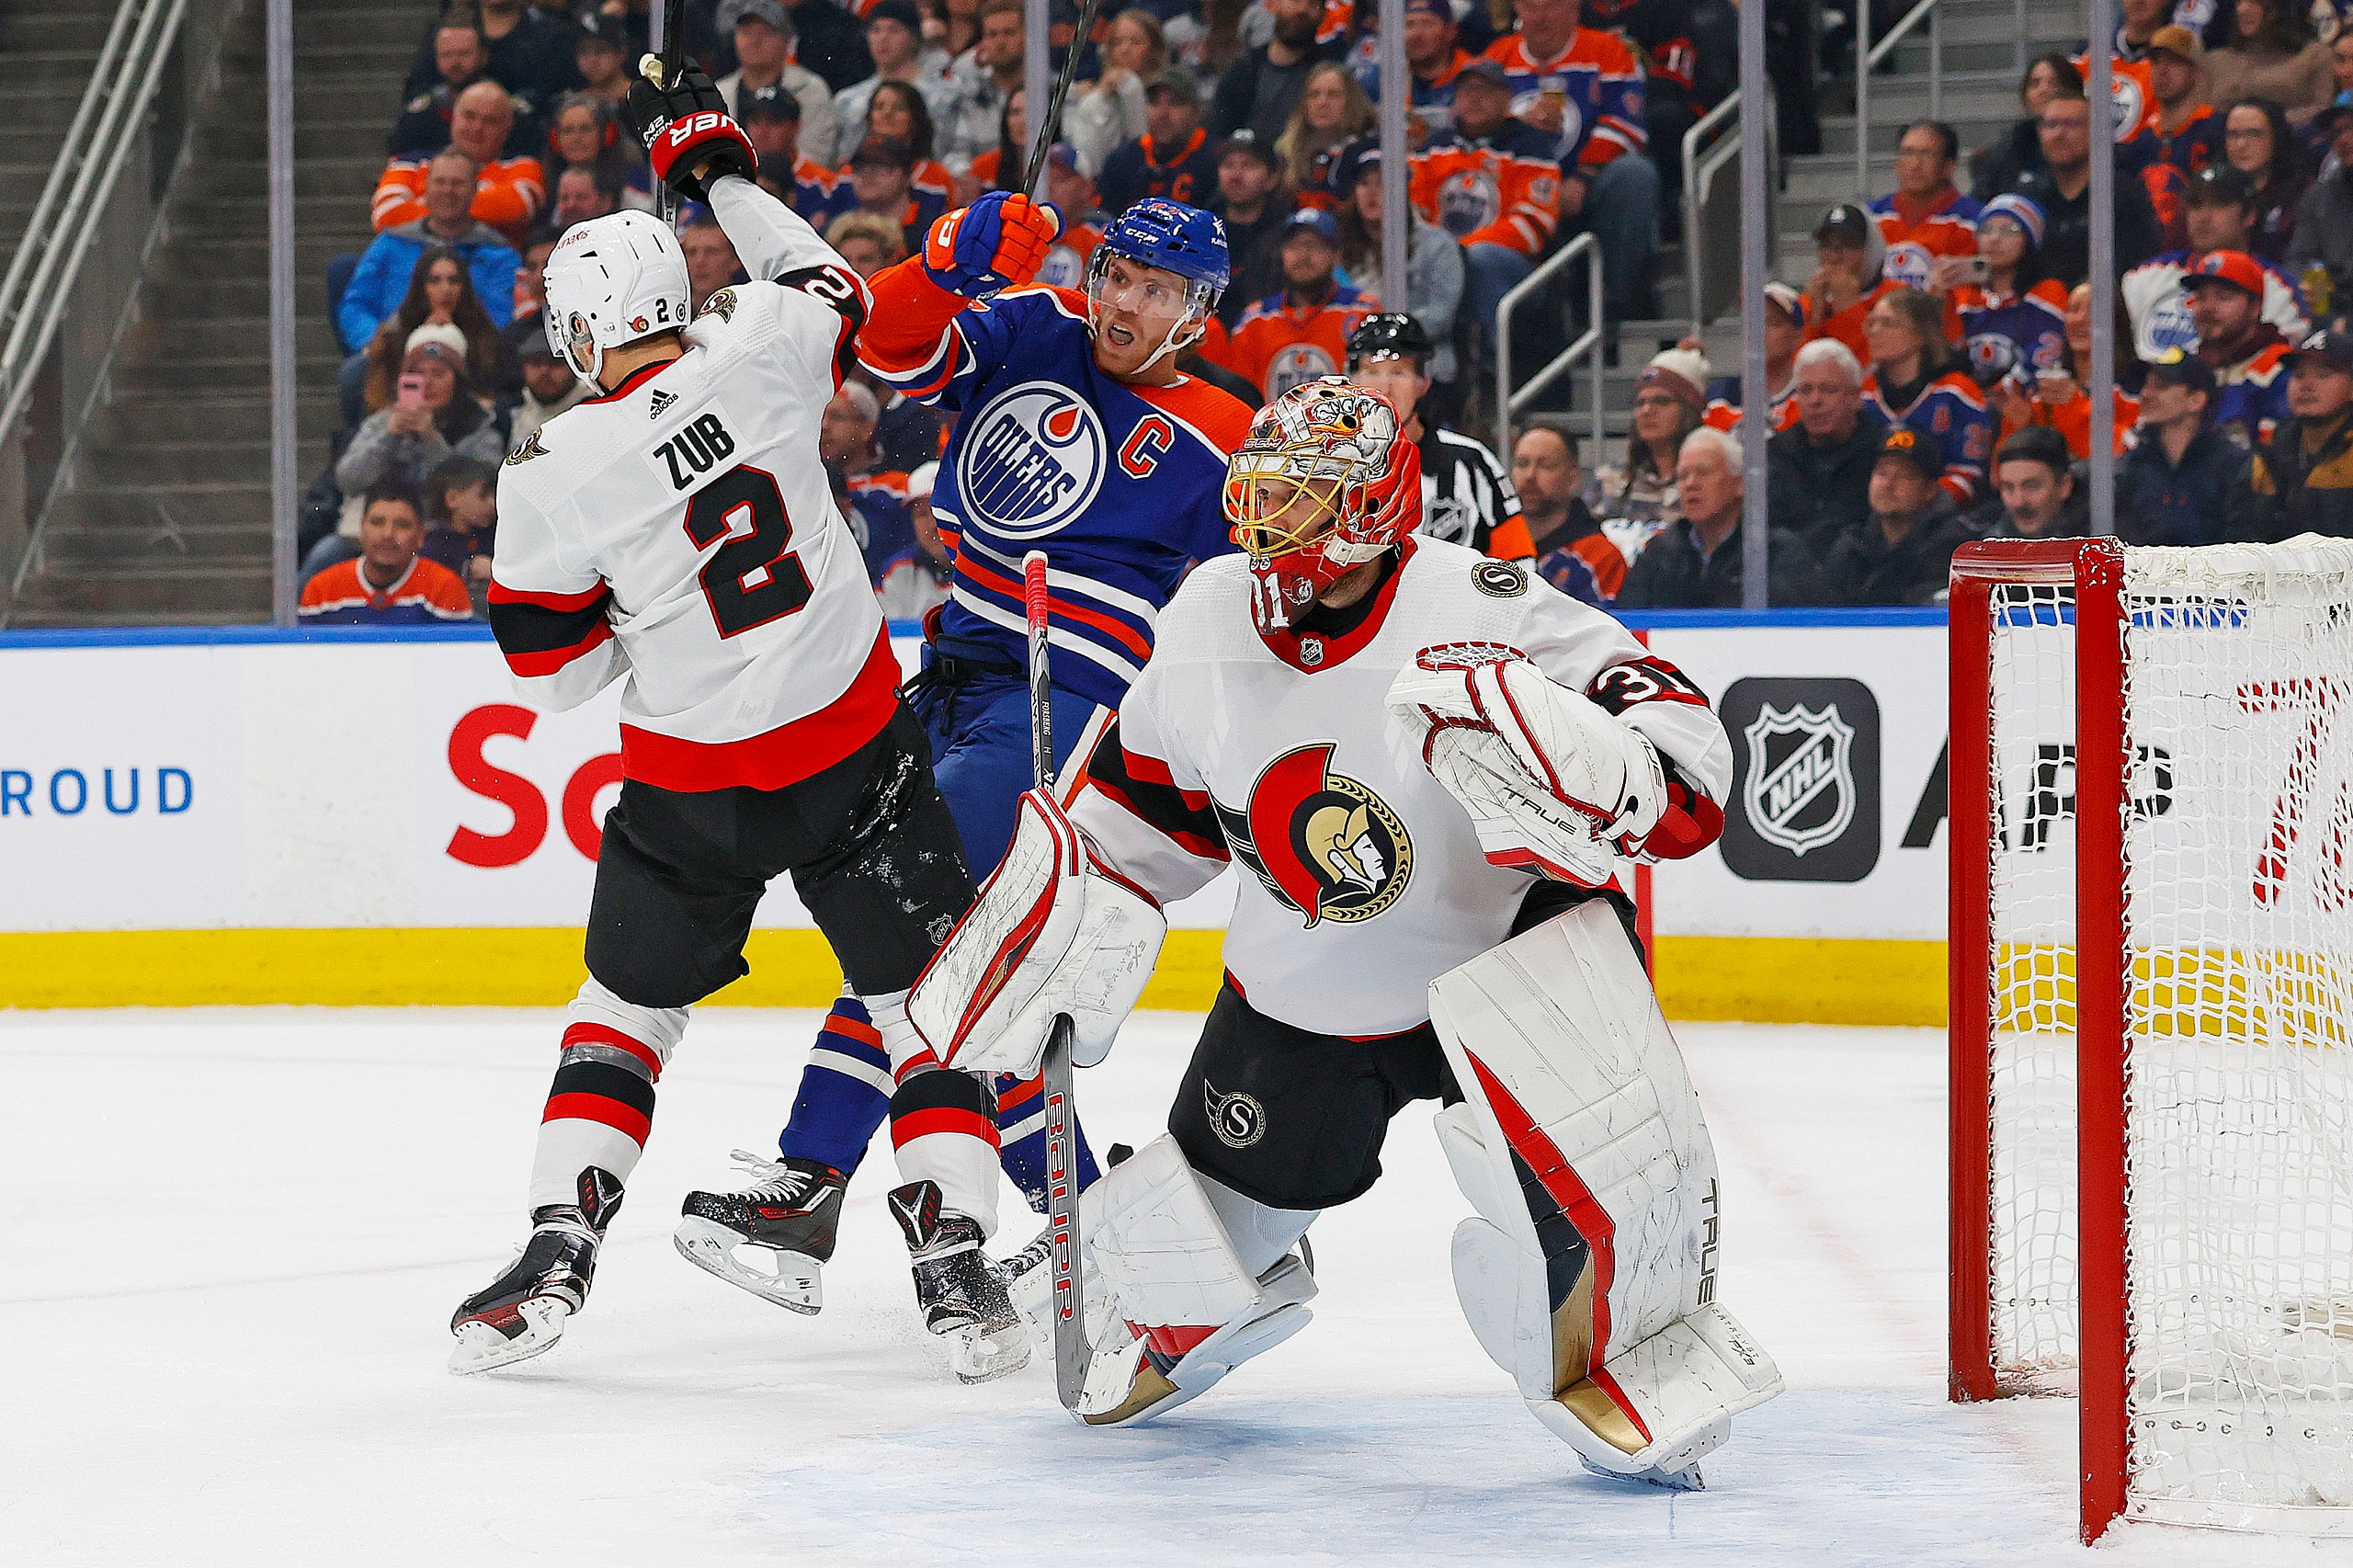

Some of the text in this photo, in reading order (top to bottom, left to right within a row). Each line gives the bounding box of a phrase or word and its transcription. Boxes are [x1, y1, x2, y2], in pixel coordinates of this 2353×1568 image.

[1124, 227, 1159, 243] CCM
[654, 297, 670, 324] 2
[804, 265, 855, 307] 2
[650, 392, 679, 420] adidas
[653, 413, 735, 491] ZUB
[972, 413, 1077, 522] OILERS
[1118, 413, 1176, 479] C
[1244, 437, 1282, 449] CCM
[683, 463, 815, 641] 2
[1041, 700, 1051, 755] FORSBERG H
[1, 768, 193, 816] ROUD
[1769, 743, 1834, 820] NHL
[1503, 787, 1577, 835] TRUE
[936, 922, 949, 941] NHL
[1226, 1103, 1253, 1137] S
[1047, 1091, 1076, 1328] BAUER
[1697, 1176, 1718, 1306] TRUE
[1711, 1308, 1760, 1359] CATALYST
